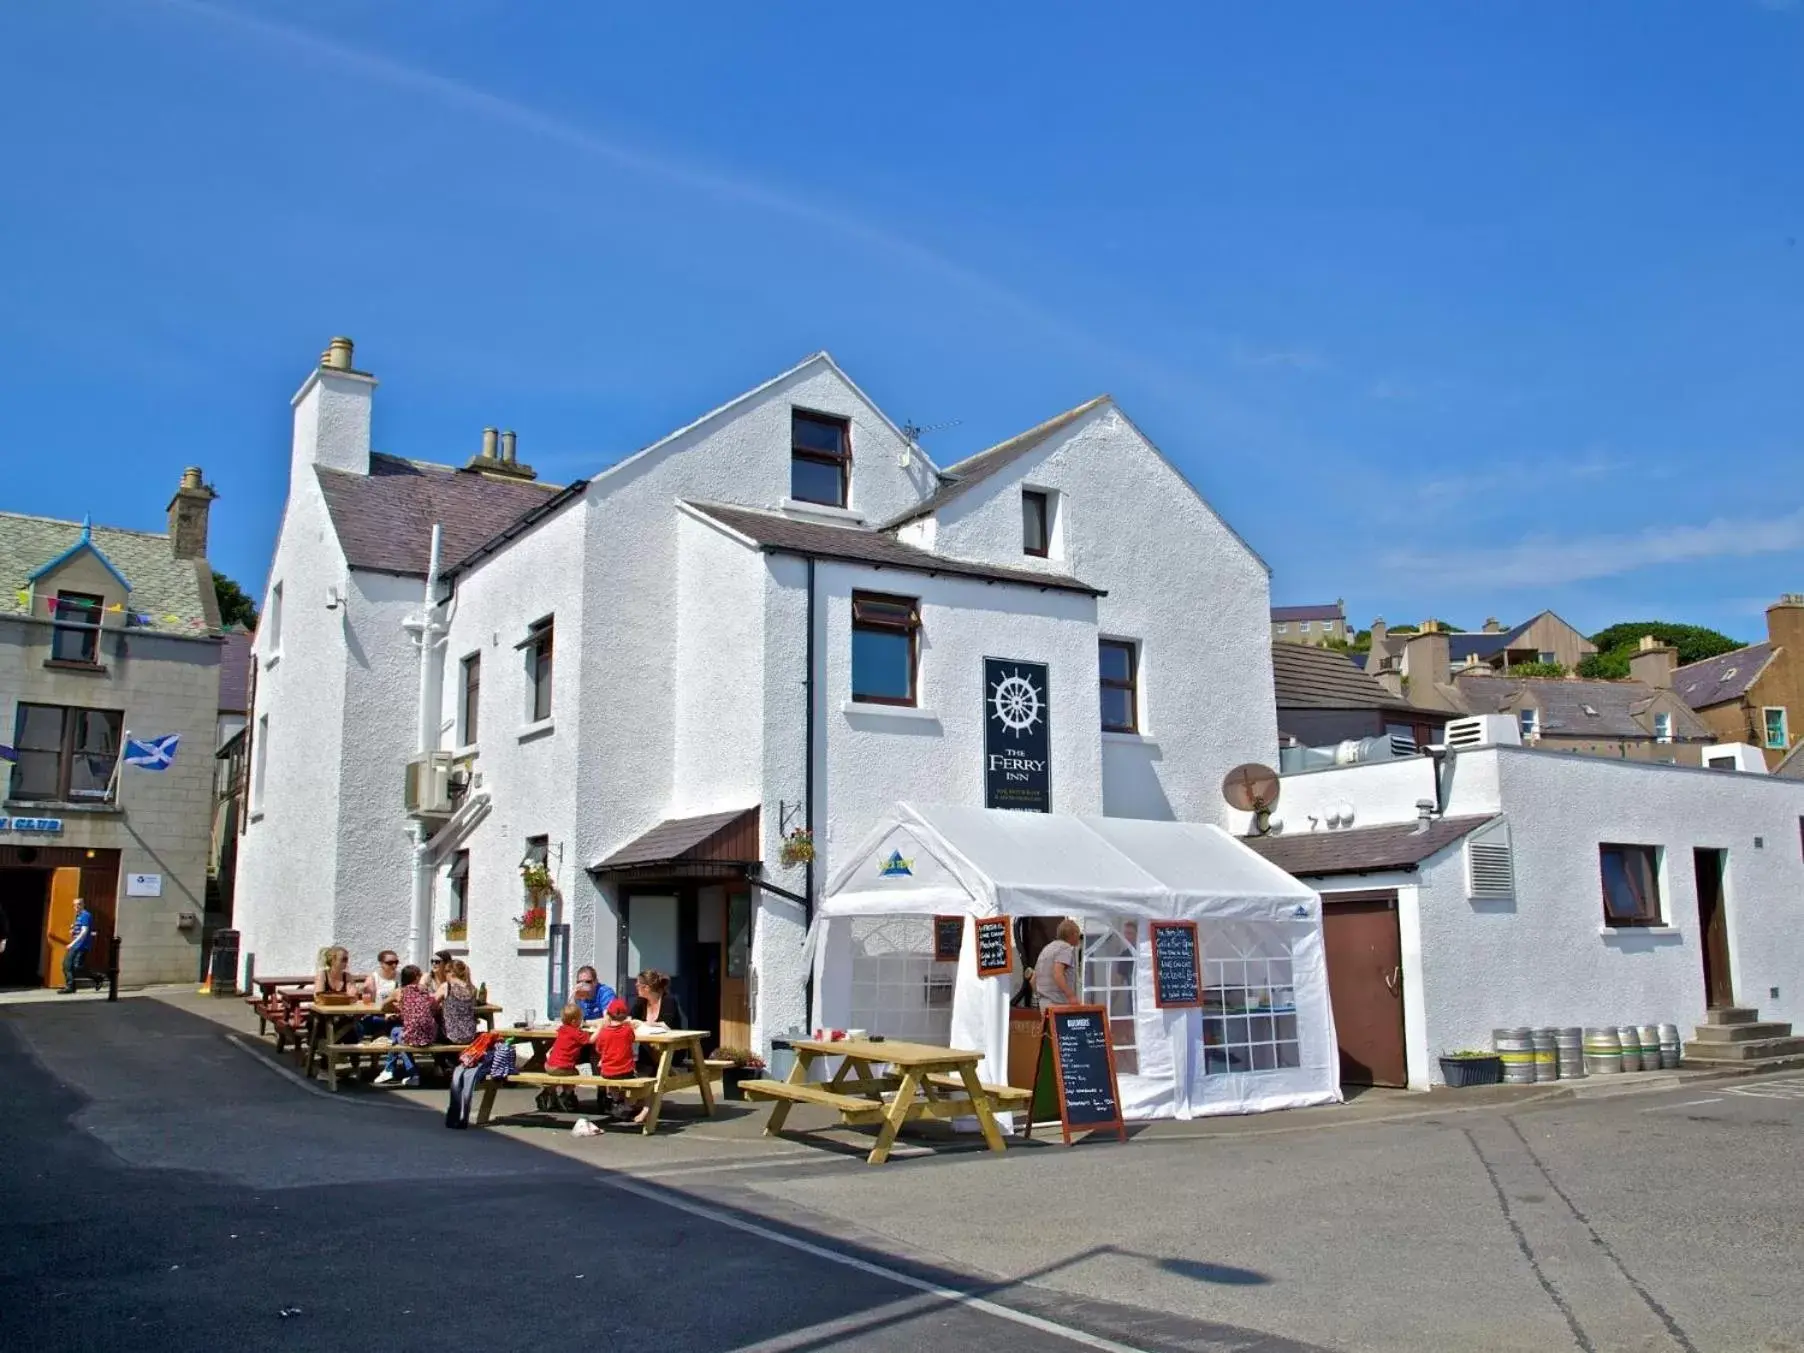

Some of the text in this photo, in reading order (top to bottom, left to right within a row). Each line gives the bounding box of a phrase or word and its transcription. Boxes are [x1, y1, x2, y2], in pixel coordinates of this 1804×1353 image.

[1005, 748, 1026, 757] THE
[988, 754, 1046, 771] FERRY
[1006, 772, 1029, 781] INN
[15, 818, 60, 829] CLUB
